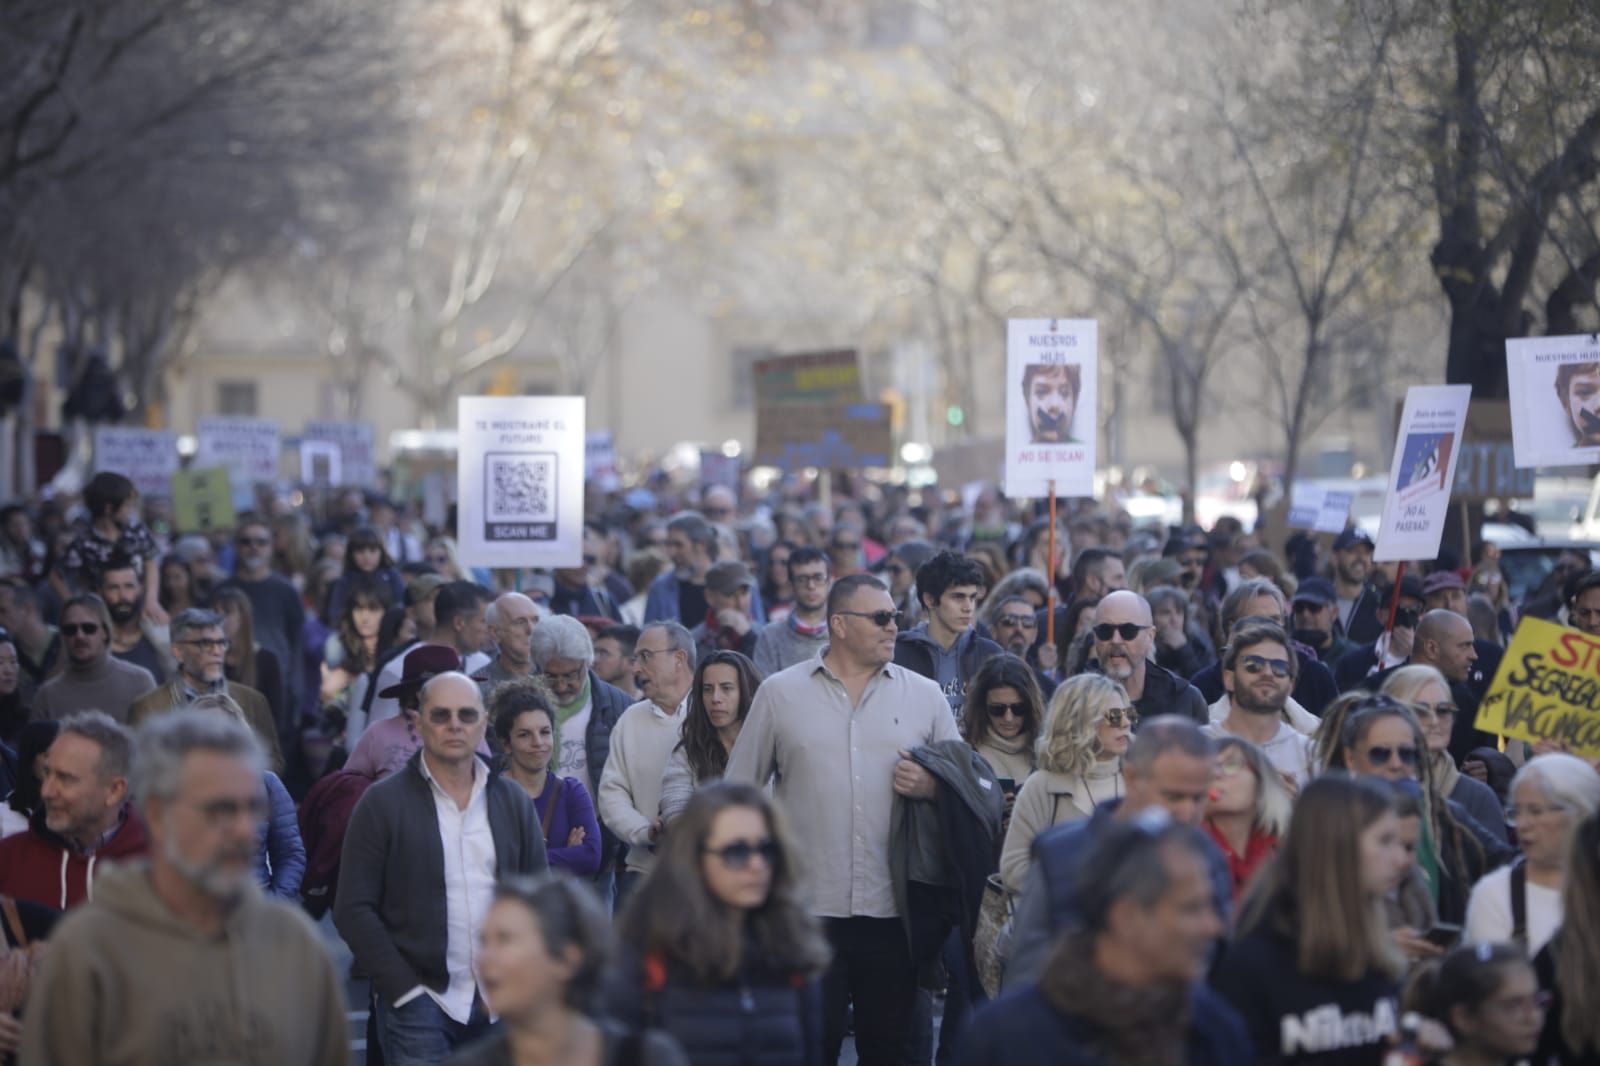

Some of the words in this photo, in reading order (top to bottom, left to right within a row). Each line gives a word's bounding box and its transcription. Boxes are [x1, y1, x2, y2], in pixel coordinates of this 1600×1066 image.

[1579, 350, 1600, 361] HIJO
[493, 524, 525, 538] SCAN
[529, 524, 549, 538] ME
[1550, 632, 1600, 676] ST
